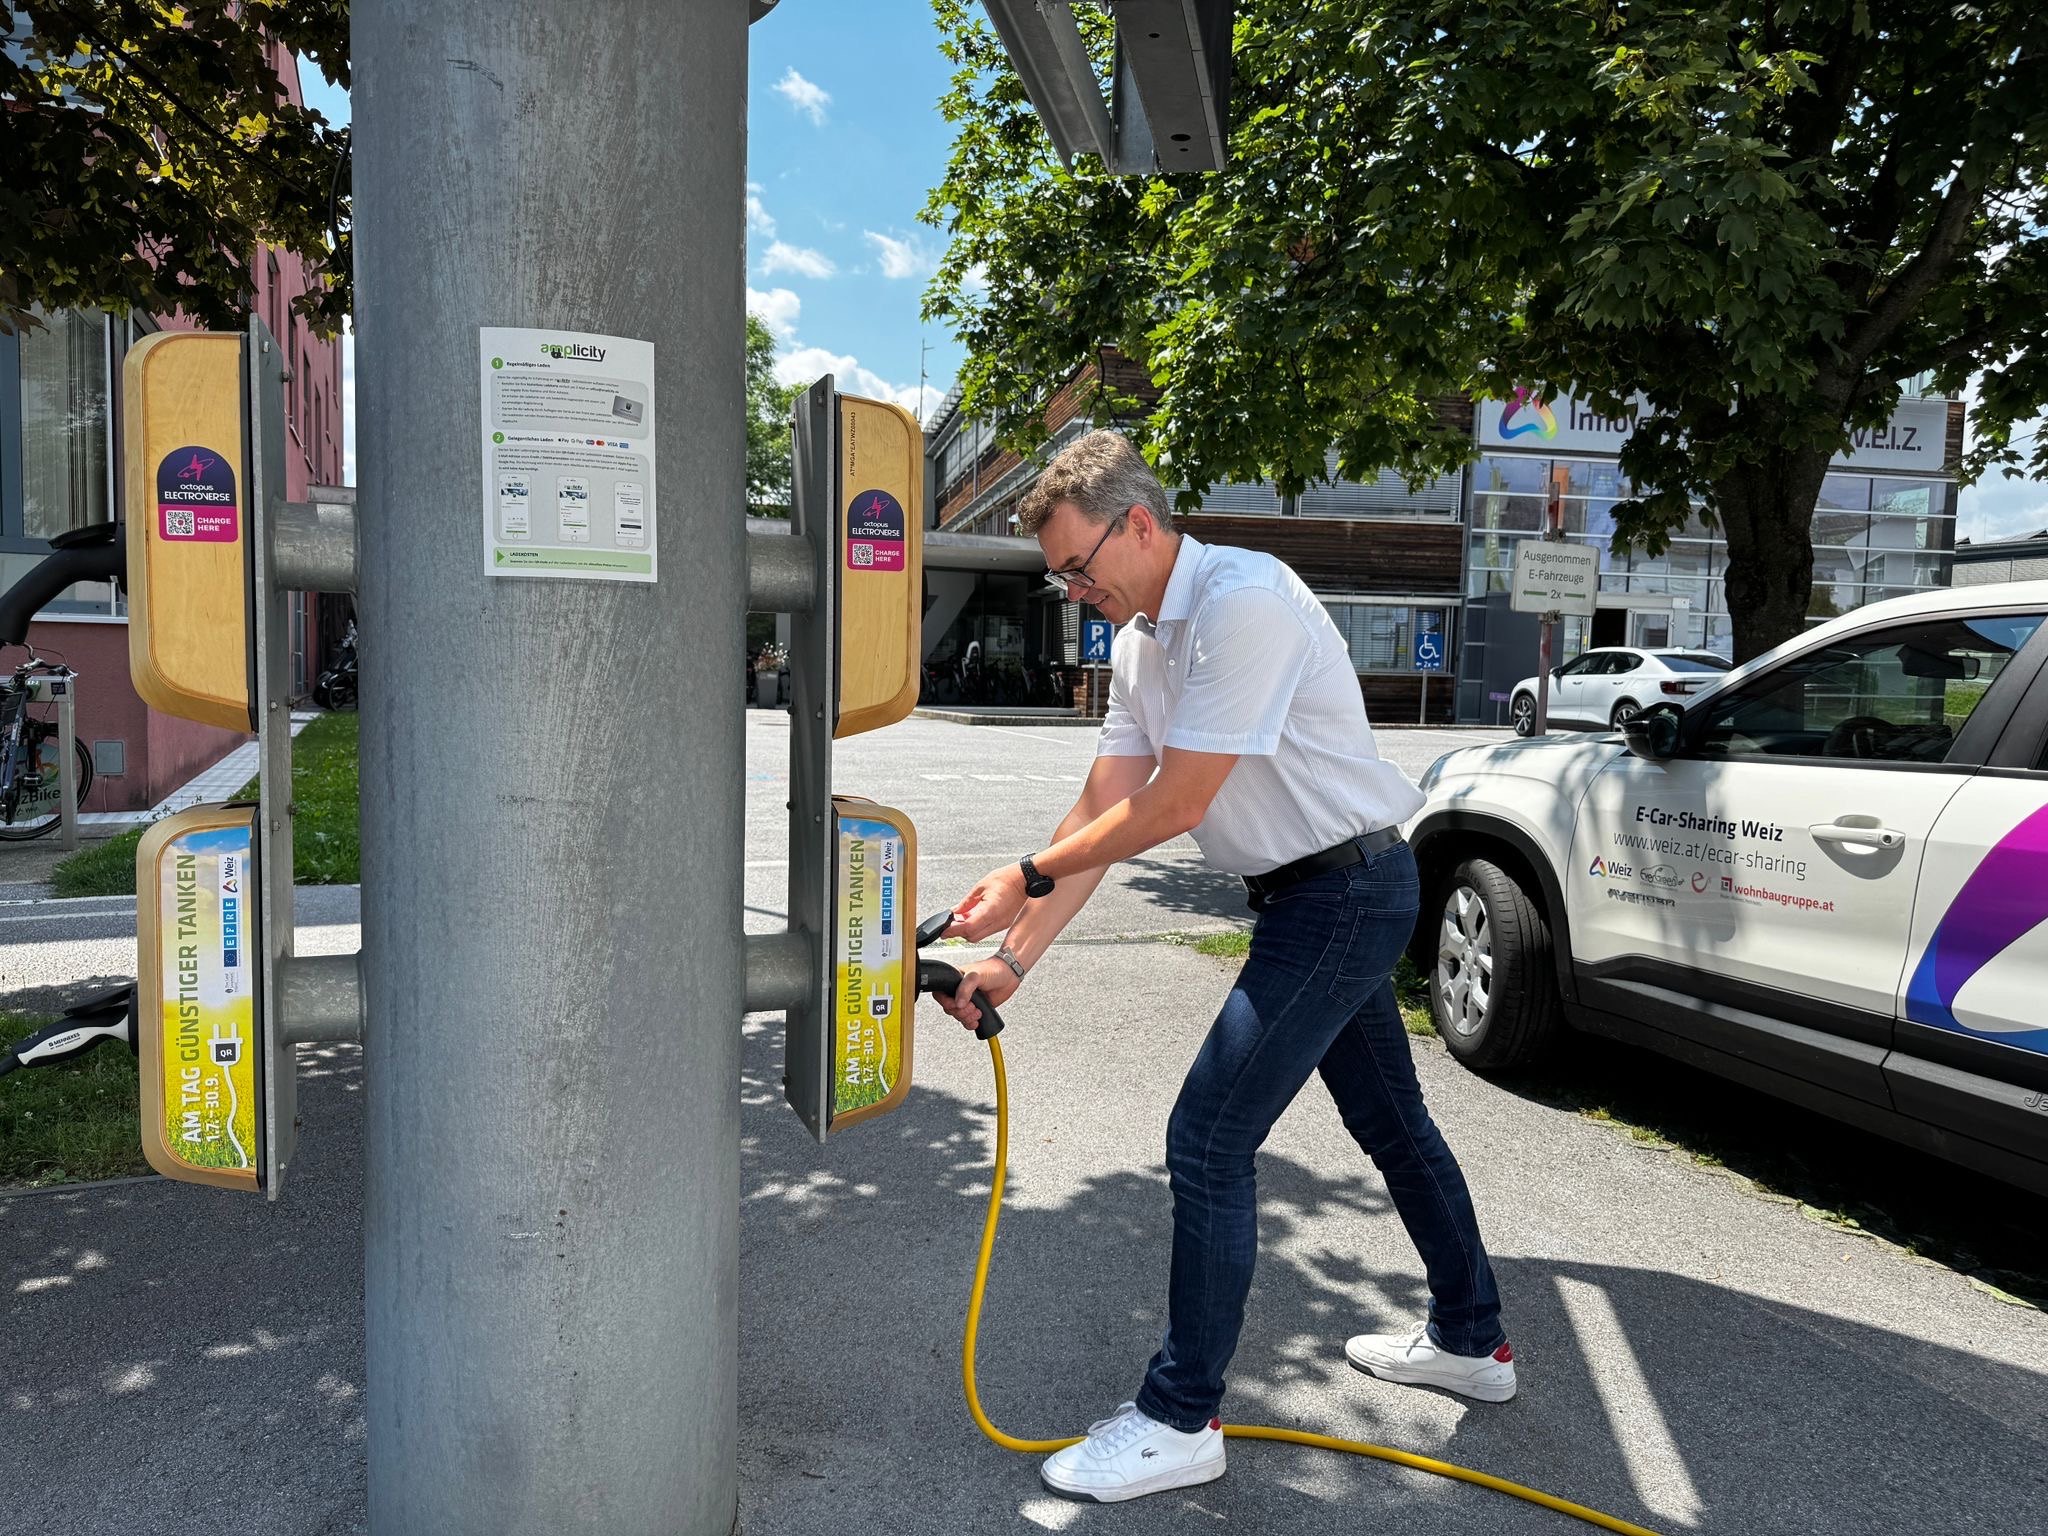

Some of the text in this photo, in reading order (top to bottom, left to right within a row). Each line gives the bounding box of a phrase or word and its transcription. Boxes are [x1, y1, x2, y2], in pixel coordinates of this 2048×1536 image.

[541, 343, 606, 361] amplicity
[164, 491, 230, 502] ELECTROVERSE
[180, 484, 214, 492] octopus
[197, 517, 232, 525] CHARGE
[864, 521, 889, 529] octopus
[852, 528, 900, 537] ELECTROVERSE
[1523, 550, 1591, 566] Ausgenommen
[1528, 568, 1584, 585] E-Fahrzeuge
[1550, 589, 1562, 600] 2x
[1092, 624, 1104, 642] P
[1636, 806, 1784, 842] E-Car-Sharing Weiz
[884, 841, 892, 860] Weiz
[1613, 832, 1807, 882] www.weiz.at/ecar-sharing
[224, 856, 234, 878] Weiz
[1608, 860, 1632, 877] Weiz
[1734, 884, 1834, 912] wohnbaugruppe.at
[844, 839, 865, 1085] AM TAG GÜNSTIGER TANKEN
[176, 854, 202, 1144] AM TAG GÜNSTIGER TANKEN
[876, 1003, 886, 1012] QR
[220, 1048, 232, 1058] QR
